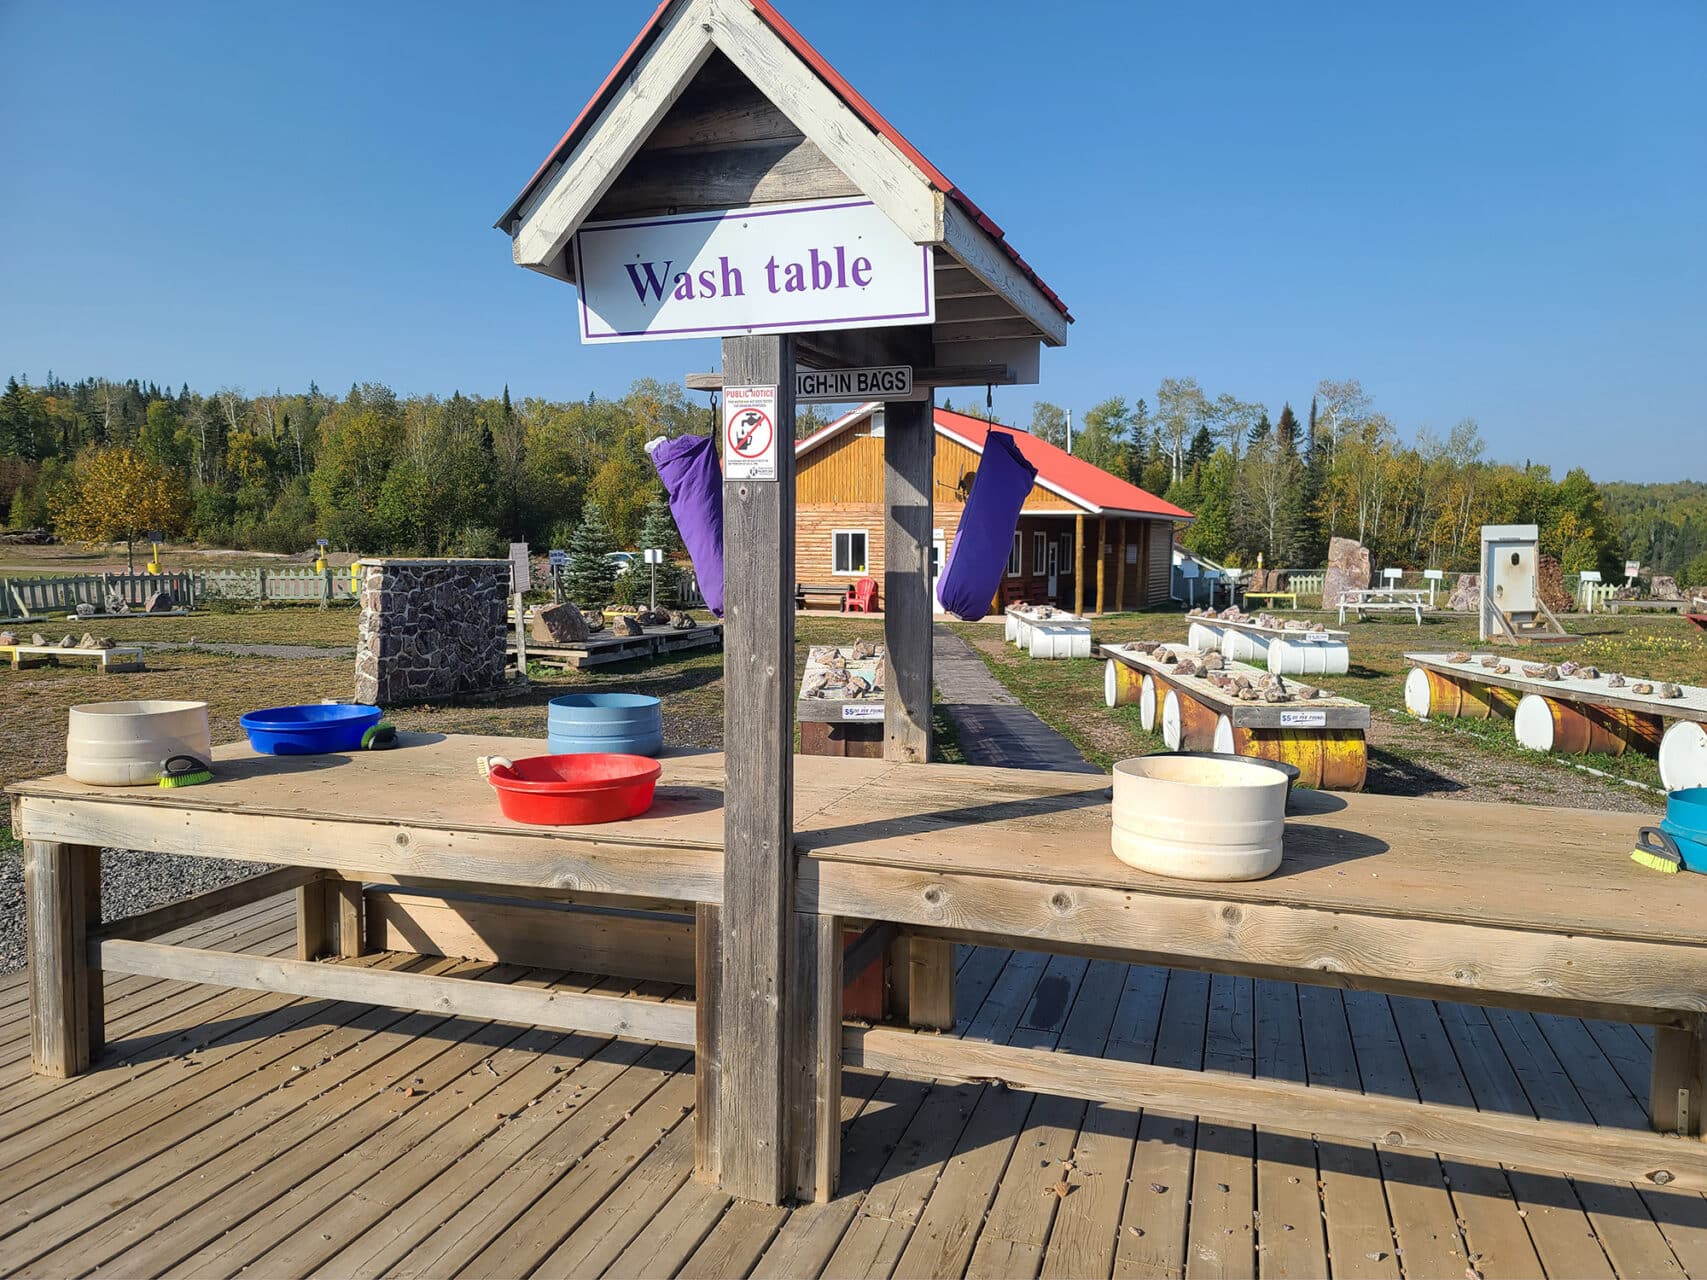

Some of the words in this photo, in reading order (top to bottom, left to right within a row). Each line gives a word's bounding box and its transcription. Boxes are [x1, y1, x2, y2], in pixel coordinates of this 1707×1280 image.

[624, 256, 745, 302] Wash
[765, 246, 873, 294] table
[726, 390, 750, 398] PUBLIC
[751, 389, 774, 398] NOTICE
[797, 374, 851, 394] IGH-IN
[857, 371, 906, 392] BAGS
